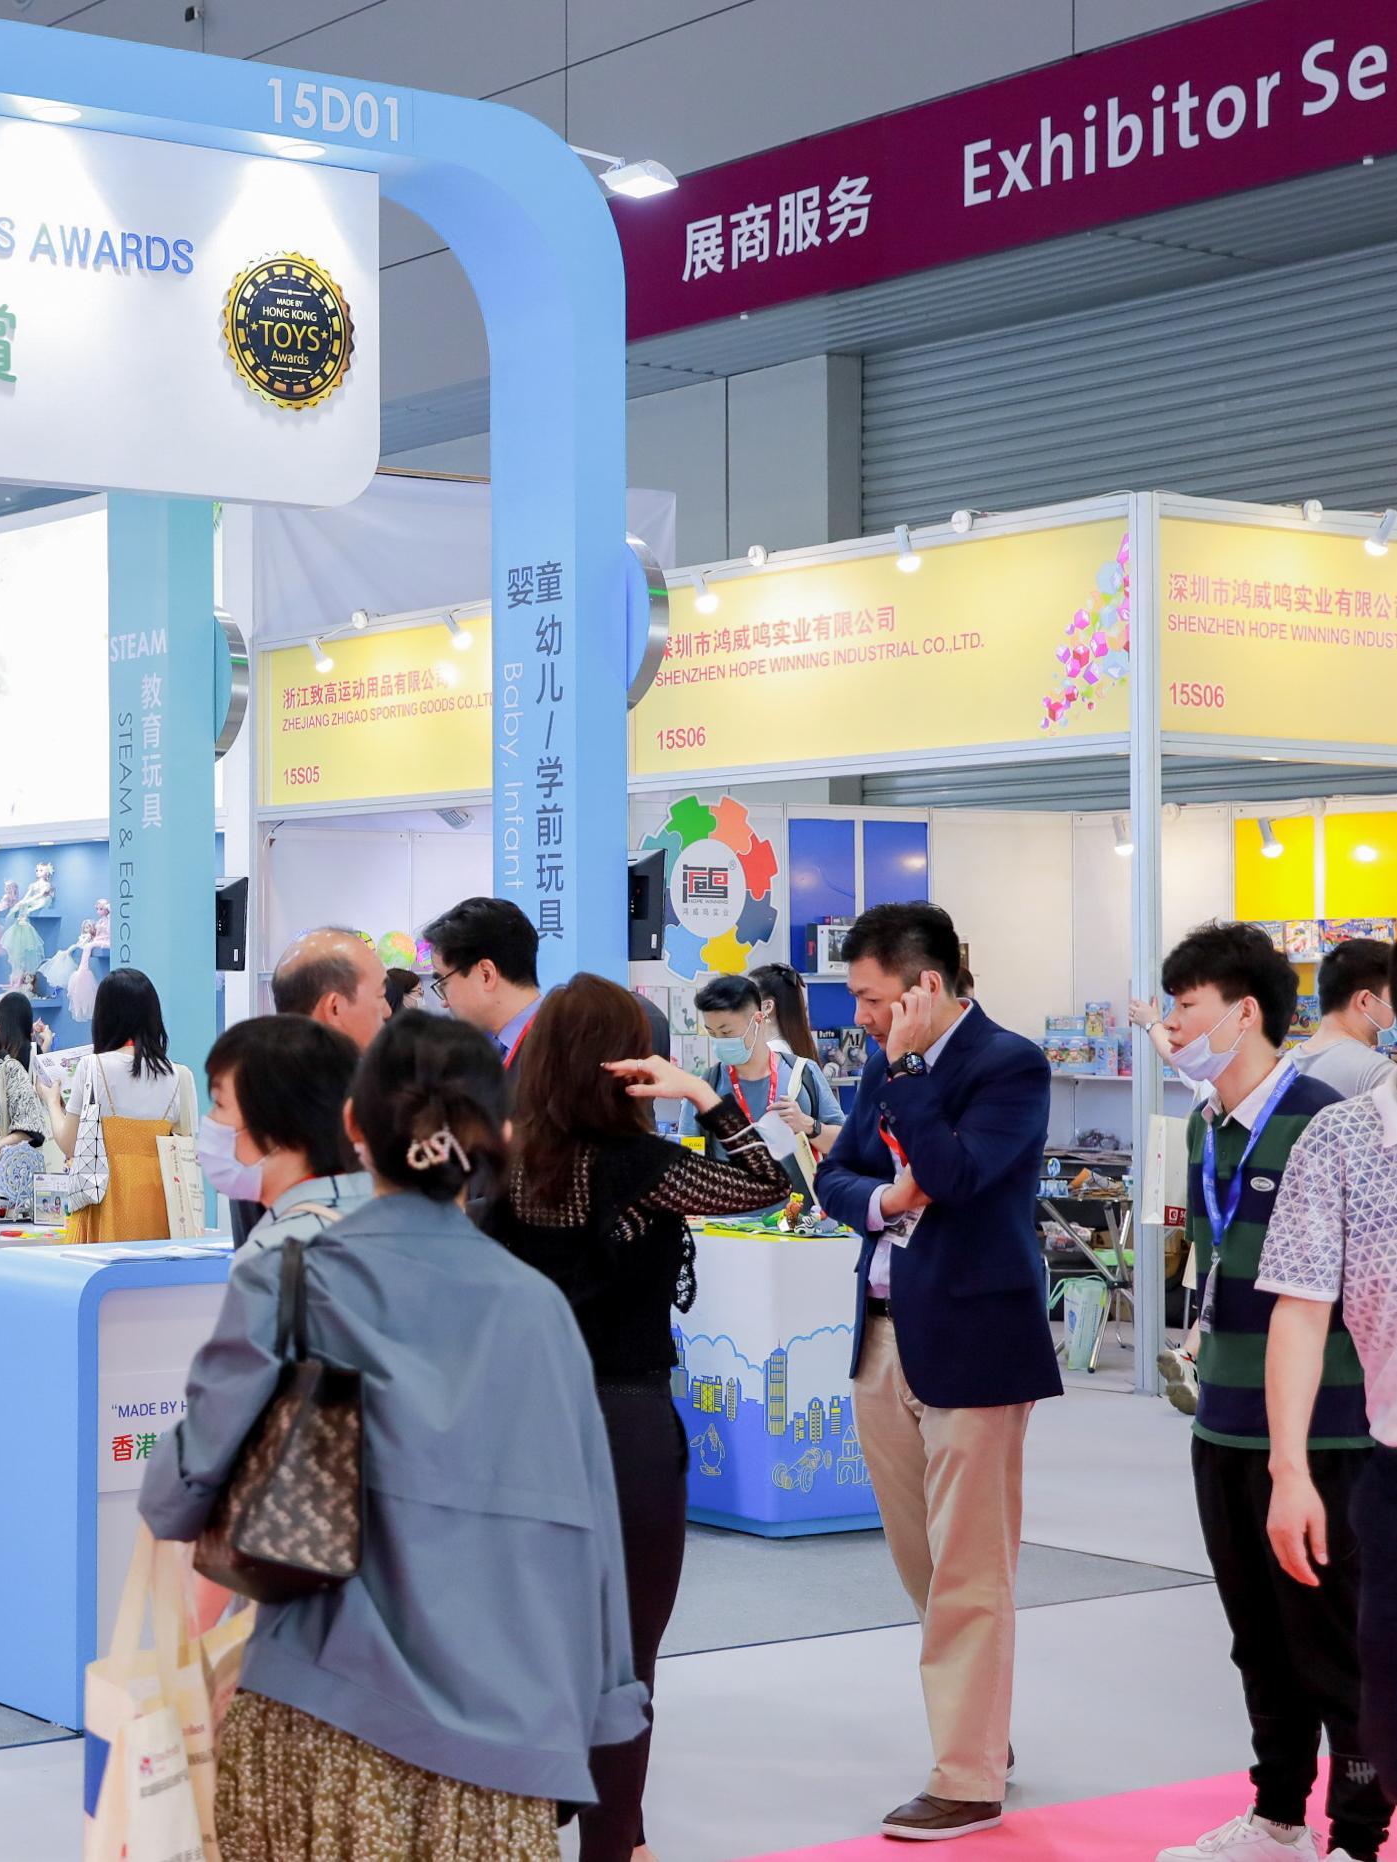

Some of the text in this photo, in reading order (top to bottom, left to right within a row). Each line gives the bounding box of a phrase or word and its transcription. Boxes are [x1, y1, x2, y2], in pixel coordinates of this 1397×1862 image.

[266, 76, 400, 142] 15D01
[962, 38, 1389, 208] Exhibitor Se
[681, 175, 873, 283] 展商服务
[30, 222, 195, 275] AWARDS
[262, 306, 318, 322] HONG KONG
[276, 297, 304, 308] MADE BY
[258, 320, 321, 352] TOYS
[271, 350, 310, 365] Awards
[109, 628, 168, 663] STEAM
[1167, 613, 1246, 637] SHENZHEN
[1248, 621, 1288, 641] HOPE
[1290, 623, 1351, 646] WINNING
[654, 663, 726, 687] SHENZHEN
[728, 658, 767, 678] HOPE
[769, 651, 830, 674] WINNING
[832, 640, 920, 667] INDUSTRIAL
[1168, 681, 1226, 709] 15S06
[281, 715, 330, 733] ZHEJIANG
[331, 708, 369, 726] ZHIGAO
[369, 701, 418, 722] SPORTING
[419, 696, 456, 714] GOODS
[140, 671, 164, 829] 教育玩具
[655, 726, 707, 752] 15S06
[117, 711, 134, 816] STEAM
[283, 765, 321, 786] 15S05
[118, 828, 134, 850] &
[503, 782, 525, 889] Infant
[160, 1401, 177, 1415] BY
